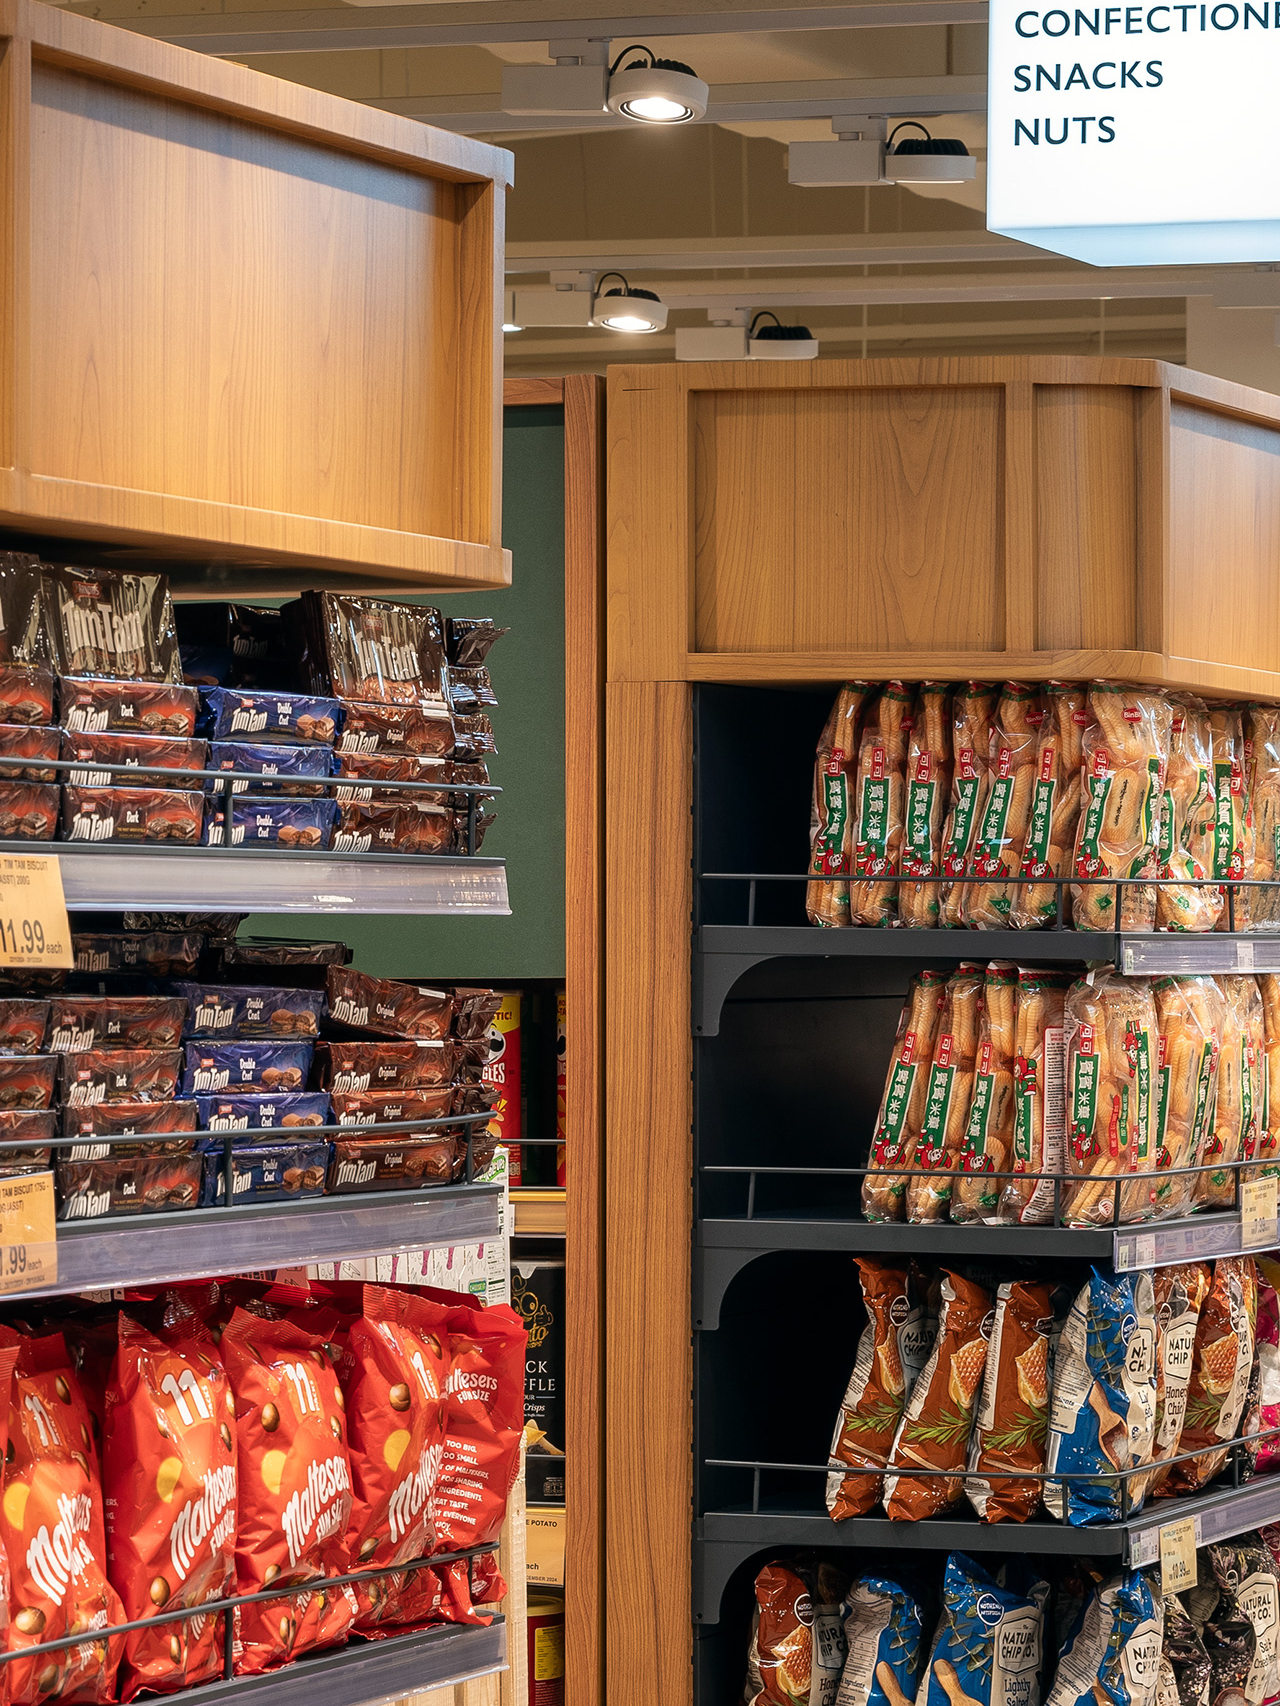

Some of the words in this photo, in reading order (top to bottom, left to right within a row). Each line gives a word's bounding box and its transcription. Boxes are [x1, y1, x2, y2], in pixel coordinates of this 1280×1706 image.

[1014, 61, 1164, 92] SNACKS
[1014, 116, 1115, 146] NUTS
[4, 860, 14, 869] TIM
[15, 860, 26, 870] TAM
[27, 861, 48, 871] BISCUIT
[46, 941, 62, 954] each
[532, 1520, 558, 1528] POTATO
[1002, 1646, 1022, 1659] CHIP
[1004, 1679, 1031, 1696] Lightly
